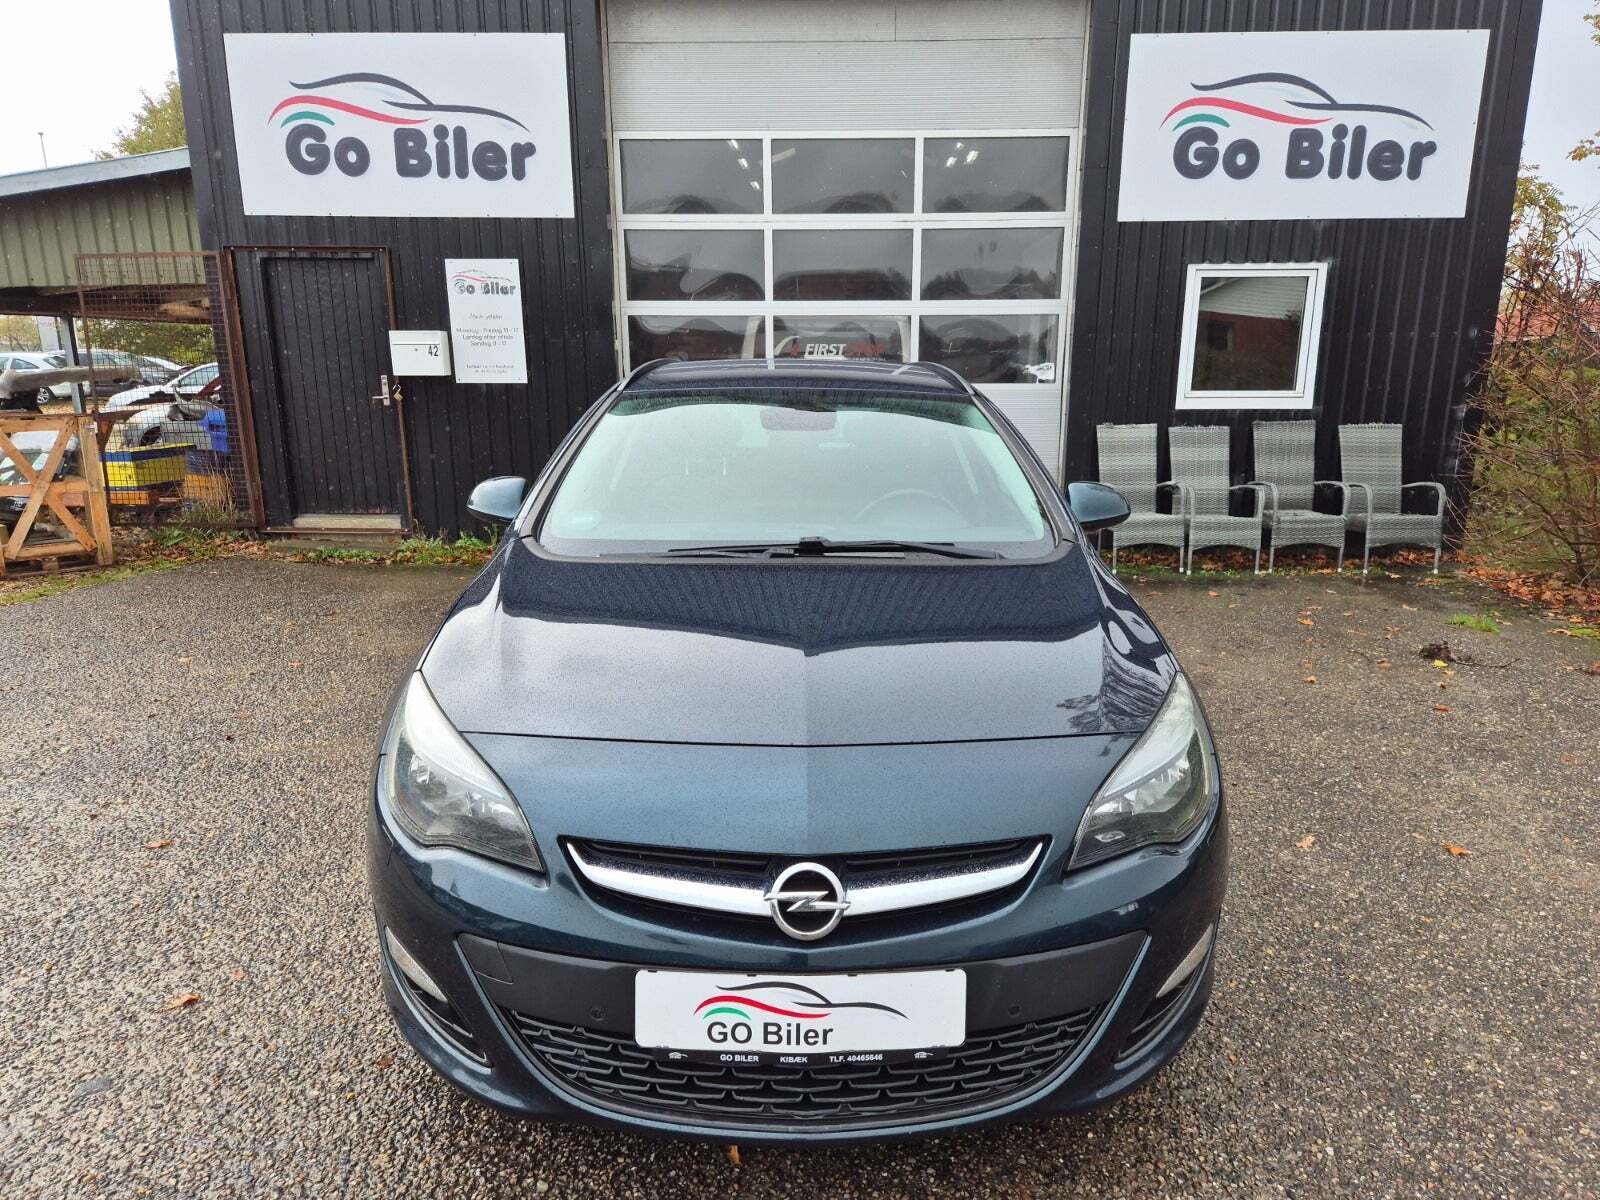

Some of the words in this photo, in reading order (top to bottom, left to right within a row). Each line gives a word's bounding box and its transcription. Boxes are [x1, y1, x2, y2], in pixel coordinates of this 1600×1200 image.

[286, 124, 371, 177] Go
[394, 124, 536, 182] Biler
[1173, 126, 1260, 180] Go
[1285, 123, 1437, 182] Biler
[454, 280, 475, 295] Go
[481, 281, 516, 295] Biler
[428, 345, 439, 357] 42
[804, 343, 847, 357] FIRST
[707, 1021, 753, 1044] GO
[763, 1022, 834, 1046] Biler
[720, 1053, 733, 1062] GO
[734, 1054, 759, 1063] BILER
[829, 1055, 846, 1063] TLF.
